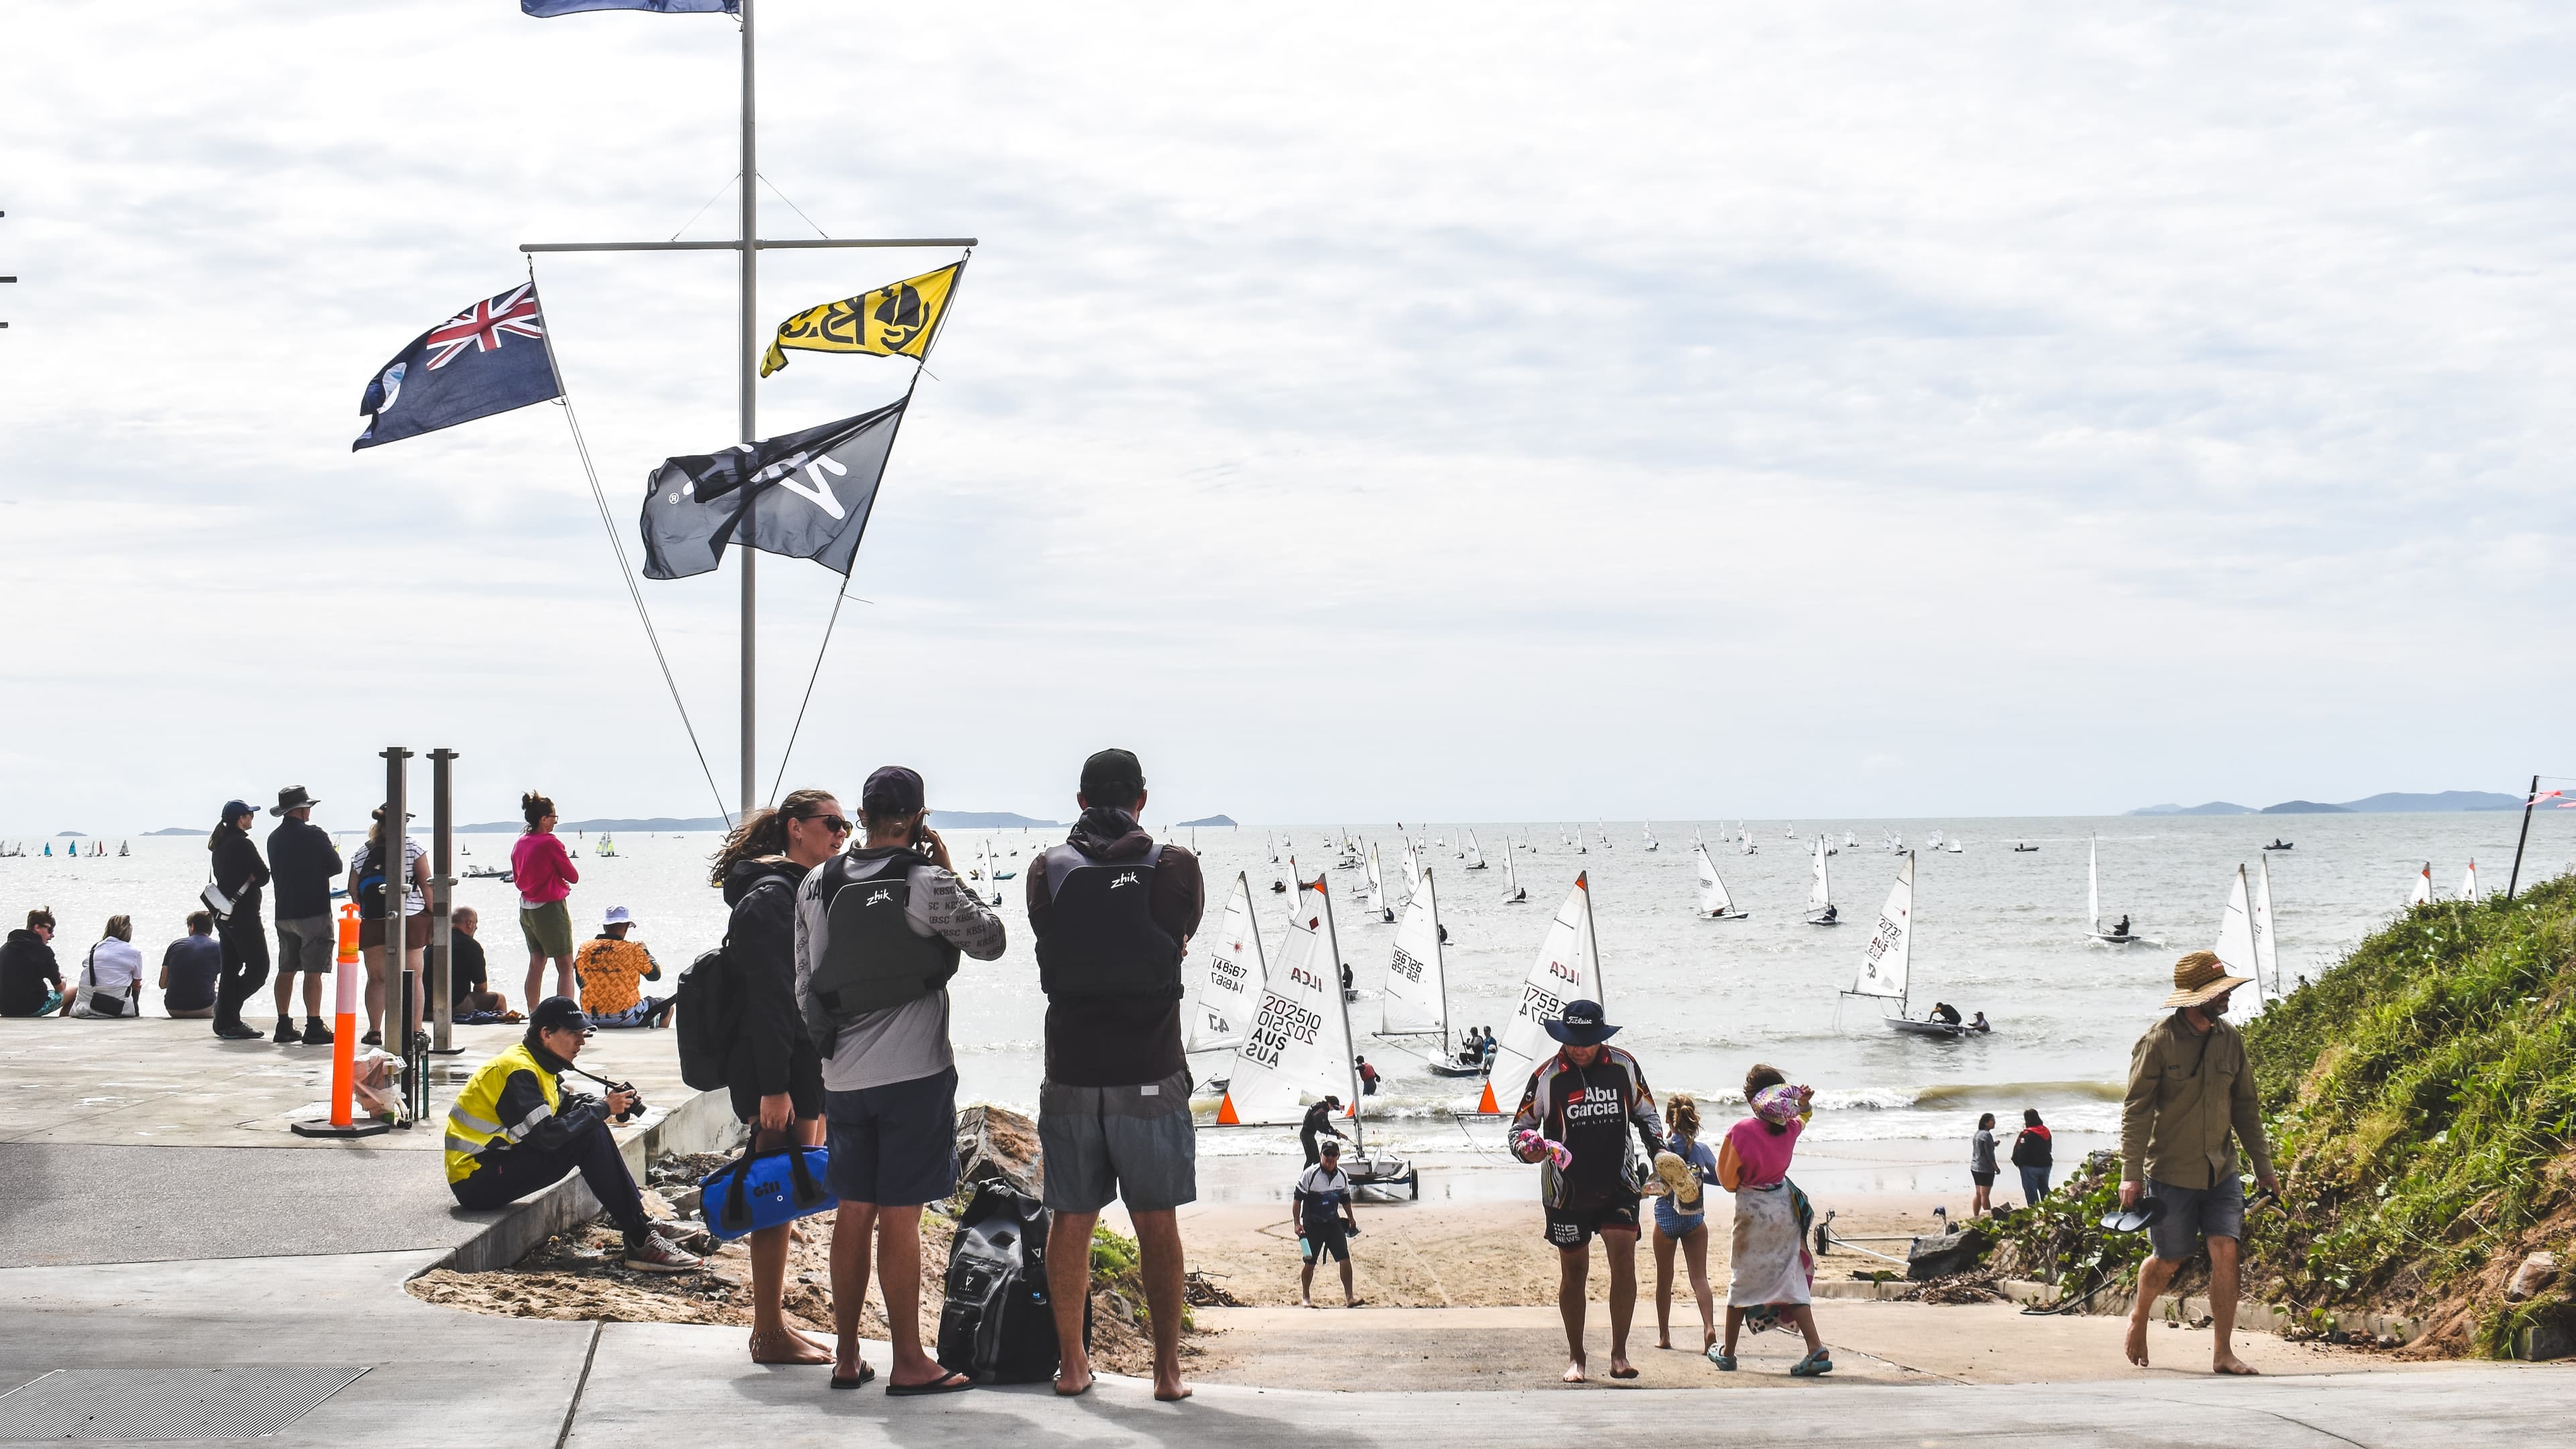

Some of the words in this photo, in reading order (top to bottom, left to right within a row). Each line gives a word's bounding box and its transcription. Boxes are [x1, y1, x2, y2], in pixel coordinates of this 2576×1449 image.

[933, 886, 956, 896] KBSC
[1872, 936, 1888, 953] AUS
[1393, 949, 1424, 973] 156726
[1263, 996, 1321, 1030] 202510
[1566, 1016, 1593, 1024] Titleist
[1251, 1028, 1287, 1051] AUS
[1585, 1087, 1617, 1102] Abu
[1567, 1102, 1619, 1120] Garcia
[753, 1181, 780, 1197] Gill
[1556, 1235, 1580, 1243] NEWS
